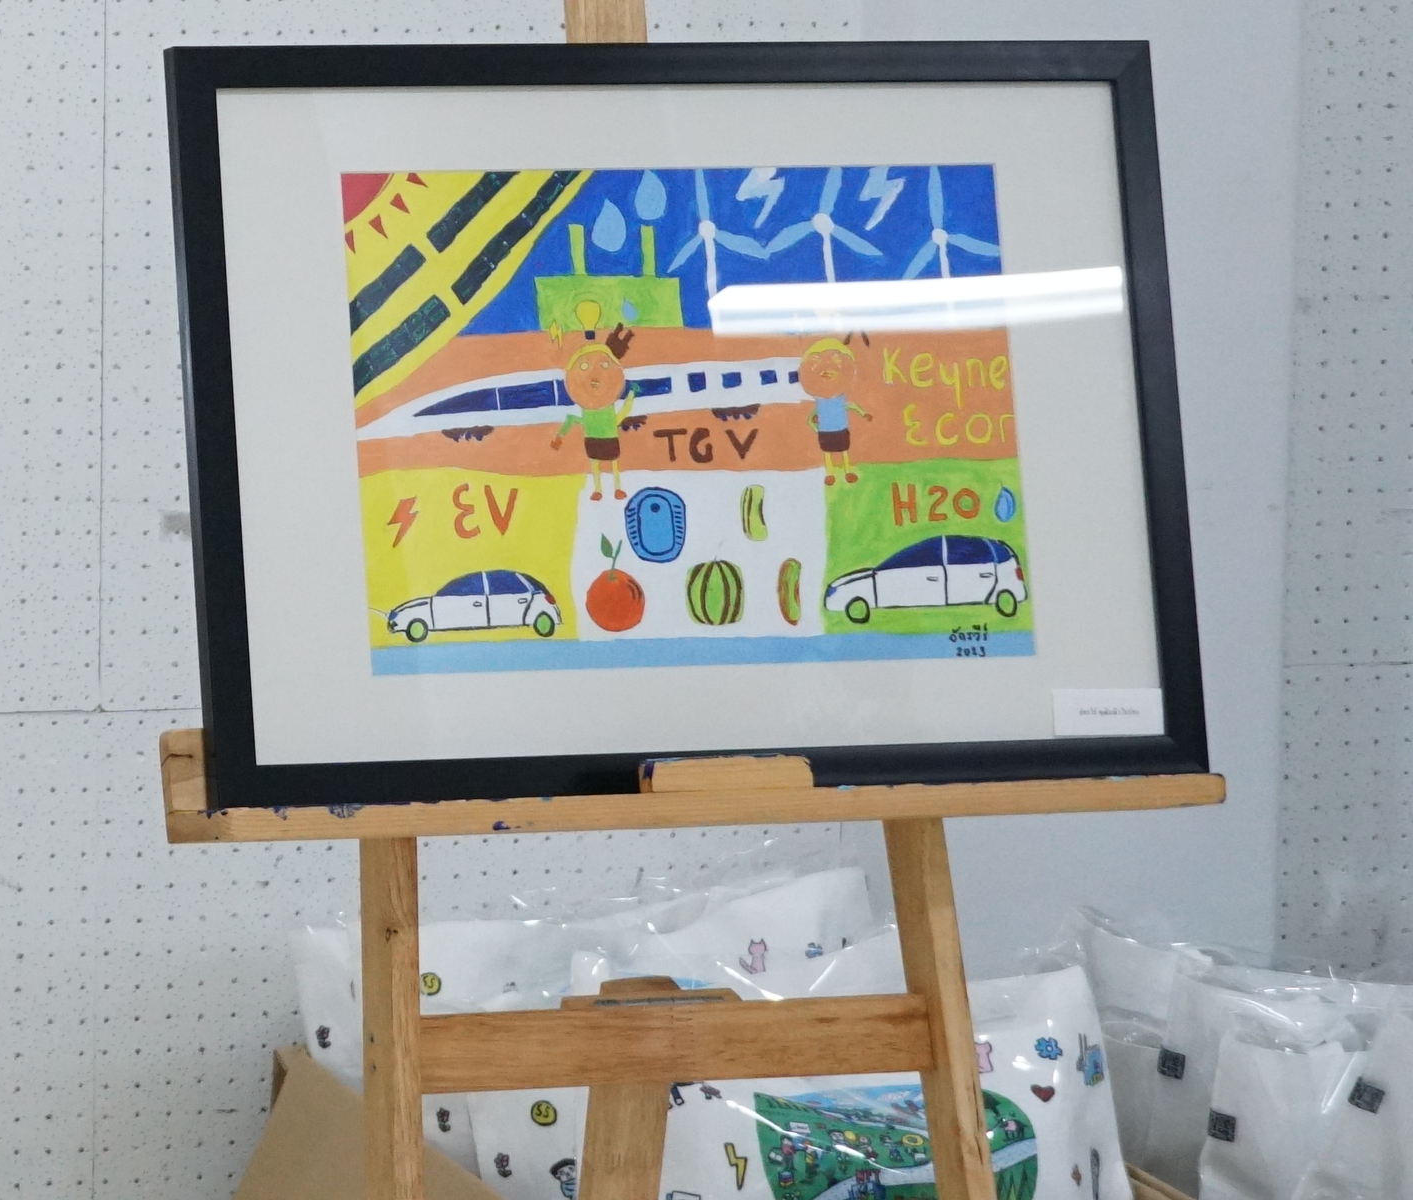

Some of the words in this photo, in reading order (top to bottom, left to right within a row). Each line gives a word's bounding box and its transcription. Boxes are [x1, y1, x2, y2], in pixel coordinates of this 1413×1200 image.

[882, 346, 1009, 410] Keyne
[653, 427, 759, 463] TGV
[452, 482, 519, 539] EV
[956, 646, 986, 657] 2023
